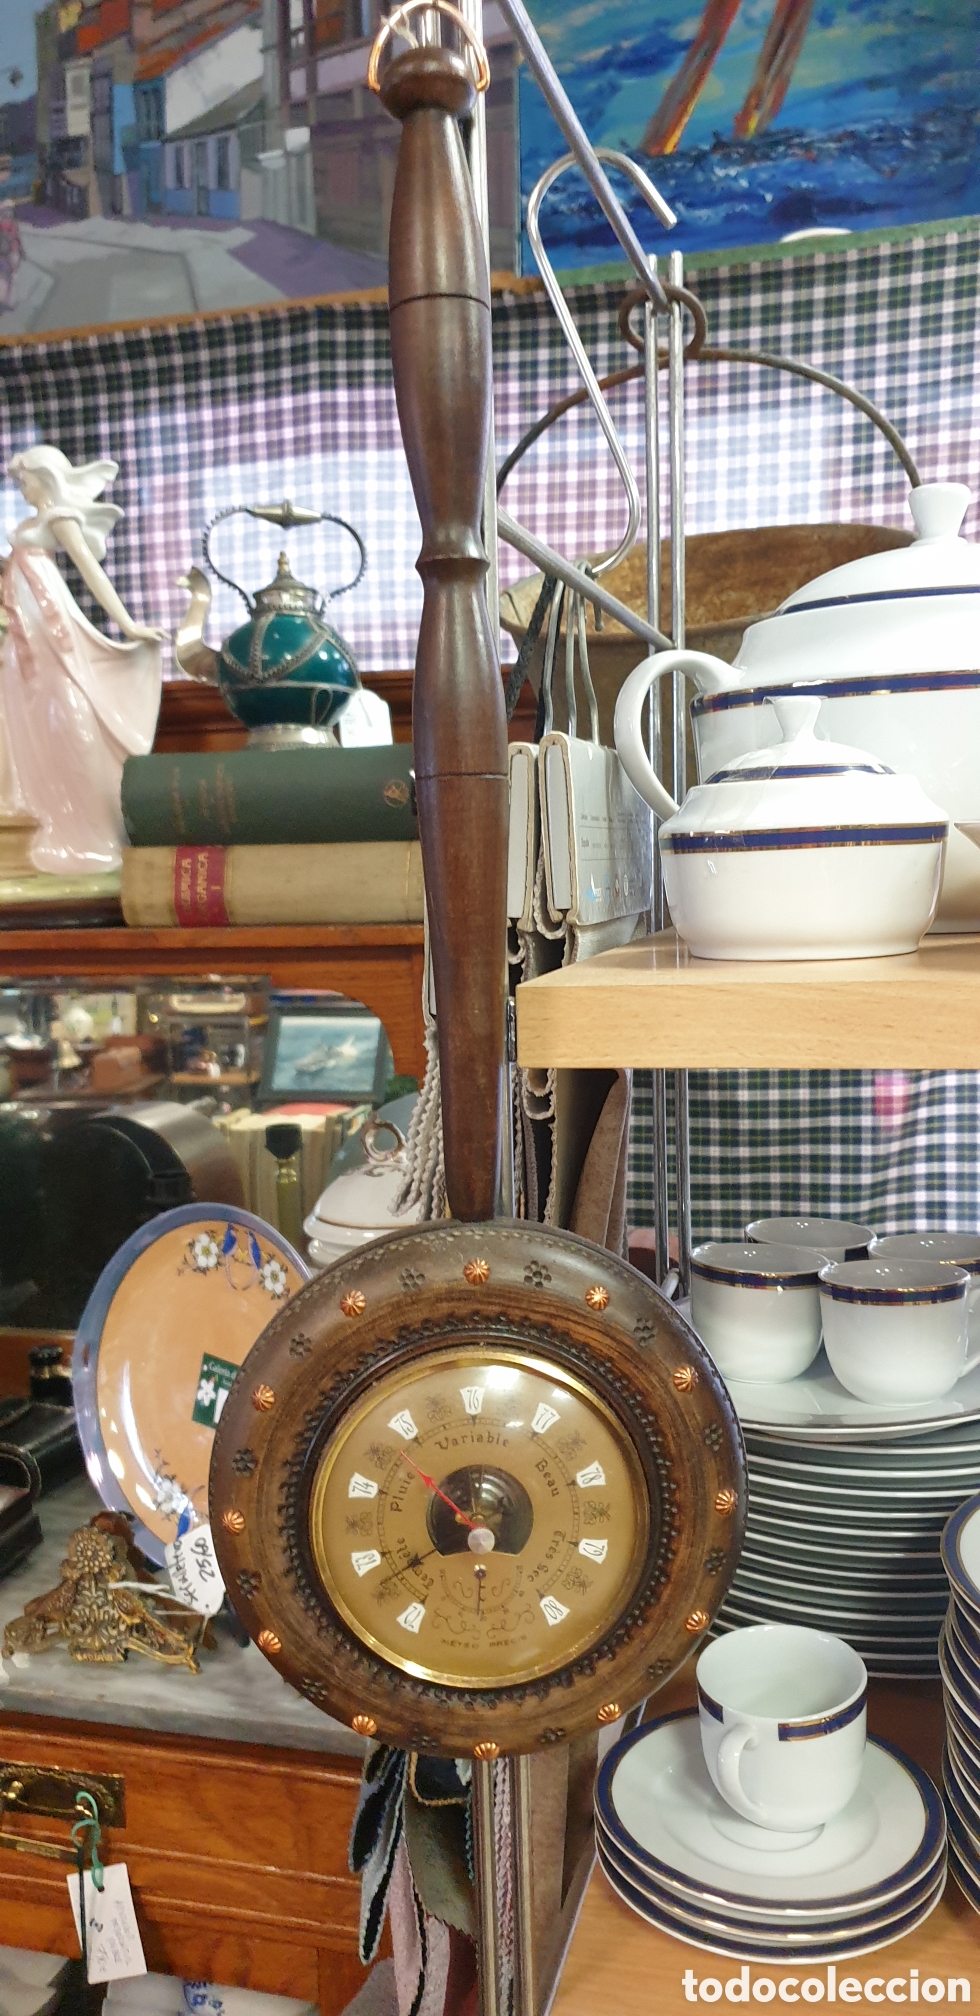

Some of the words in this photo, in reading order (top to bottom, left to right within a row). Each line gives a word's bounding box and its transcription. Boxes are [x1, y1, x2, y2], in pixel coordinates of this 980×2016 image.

[467, 1388, 480, 1411] 76
[394, 1413, 415, 1437] 75
[535, 1407, 556, 1430] 77
[433, 1430, 510, 1451] Variable
[535, 1457, 560, 1497] Beau
[579, 1466, 603, 1485] 78
[351, 1480, 375, 1495] 74
[390, 1471, 416, 1513] Pluie
[582, 1541, 606, 1557] 79
[403, 1605, 422, 1629] 72
[543, 1599, 564, 1620] 80
